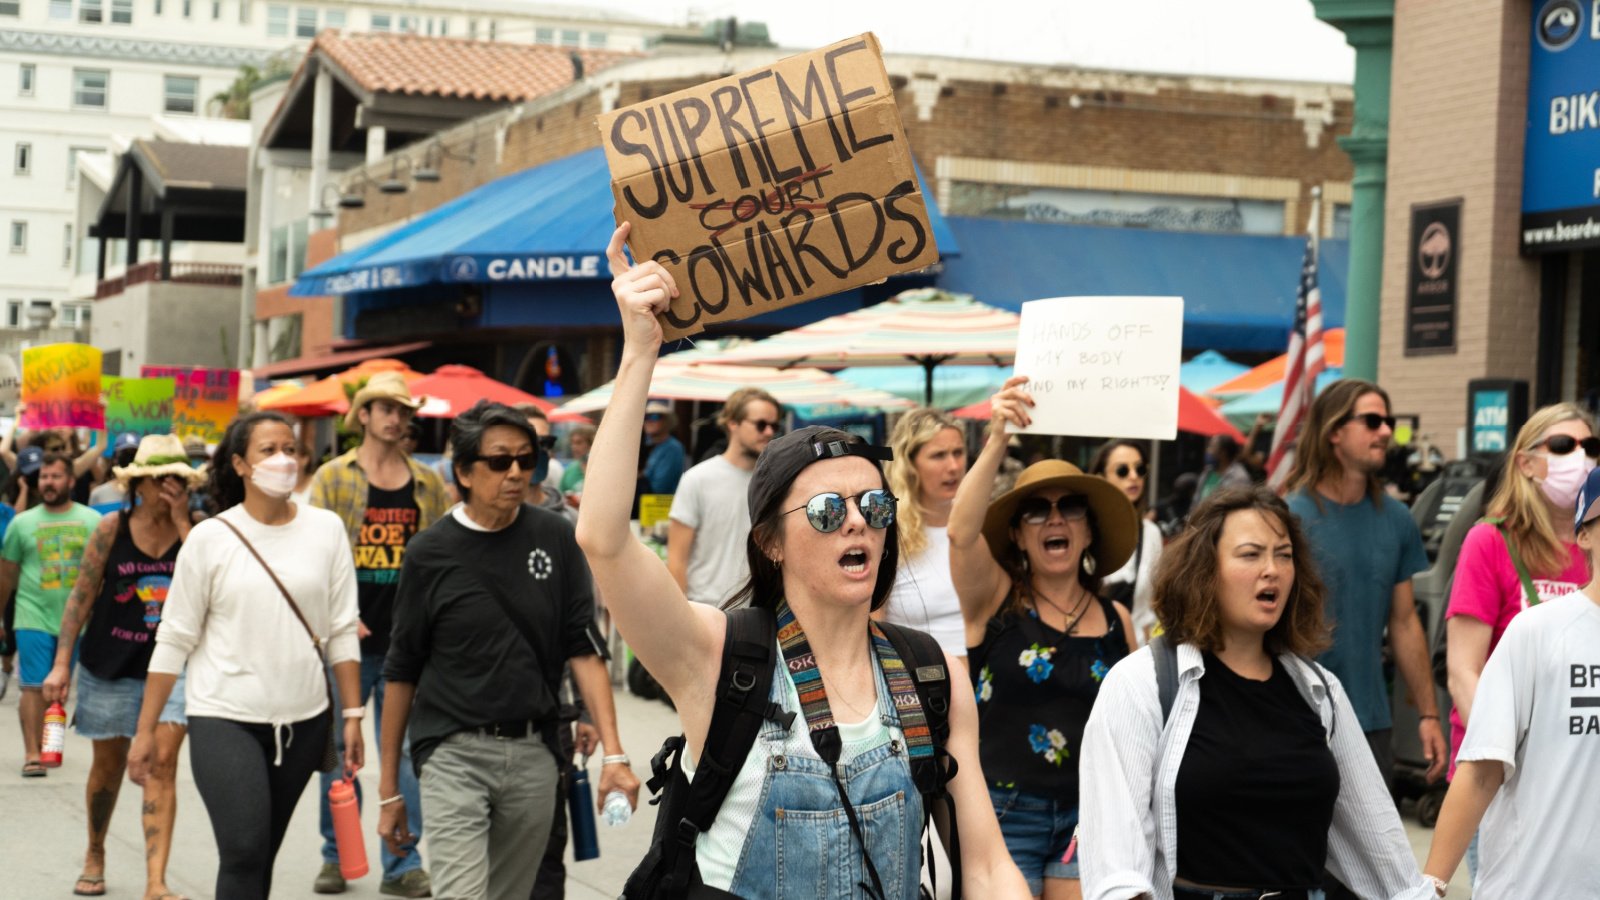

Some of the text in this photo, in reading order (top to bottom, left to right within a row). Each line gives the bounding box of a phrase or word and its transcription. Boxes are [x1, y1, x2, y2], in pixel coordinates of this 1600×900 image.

[1549, 90, 1600, 135] BIK
[610, 40, 895, 220] SUPREME
[699, 168, 834, 231] COURT
[650, 179, 927, 329] COWARDS
[486, 255, 600, 280] CANDLE
[1032, 320, 1154, 345] HANDS OFF
[1034, 349, 1124, 367] MY BODY
[1023, 377, 1055, 393] AND
[1066, 378, 1088, 390] MY
[117, 562, 136, 576] NO
[1569, 715, 1600, 735] BA
